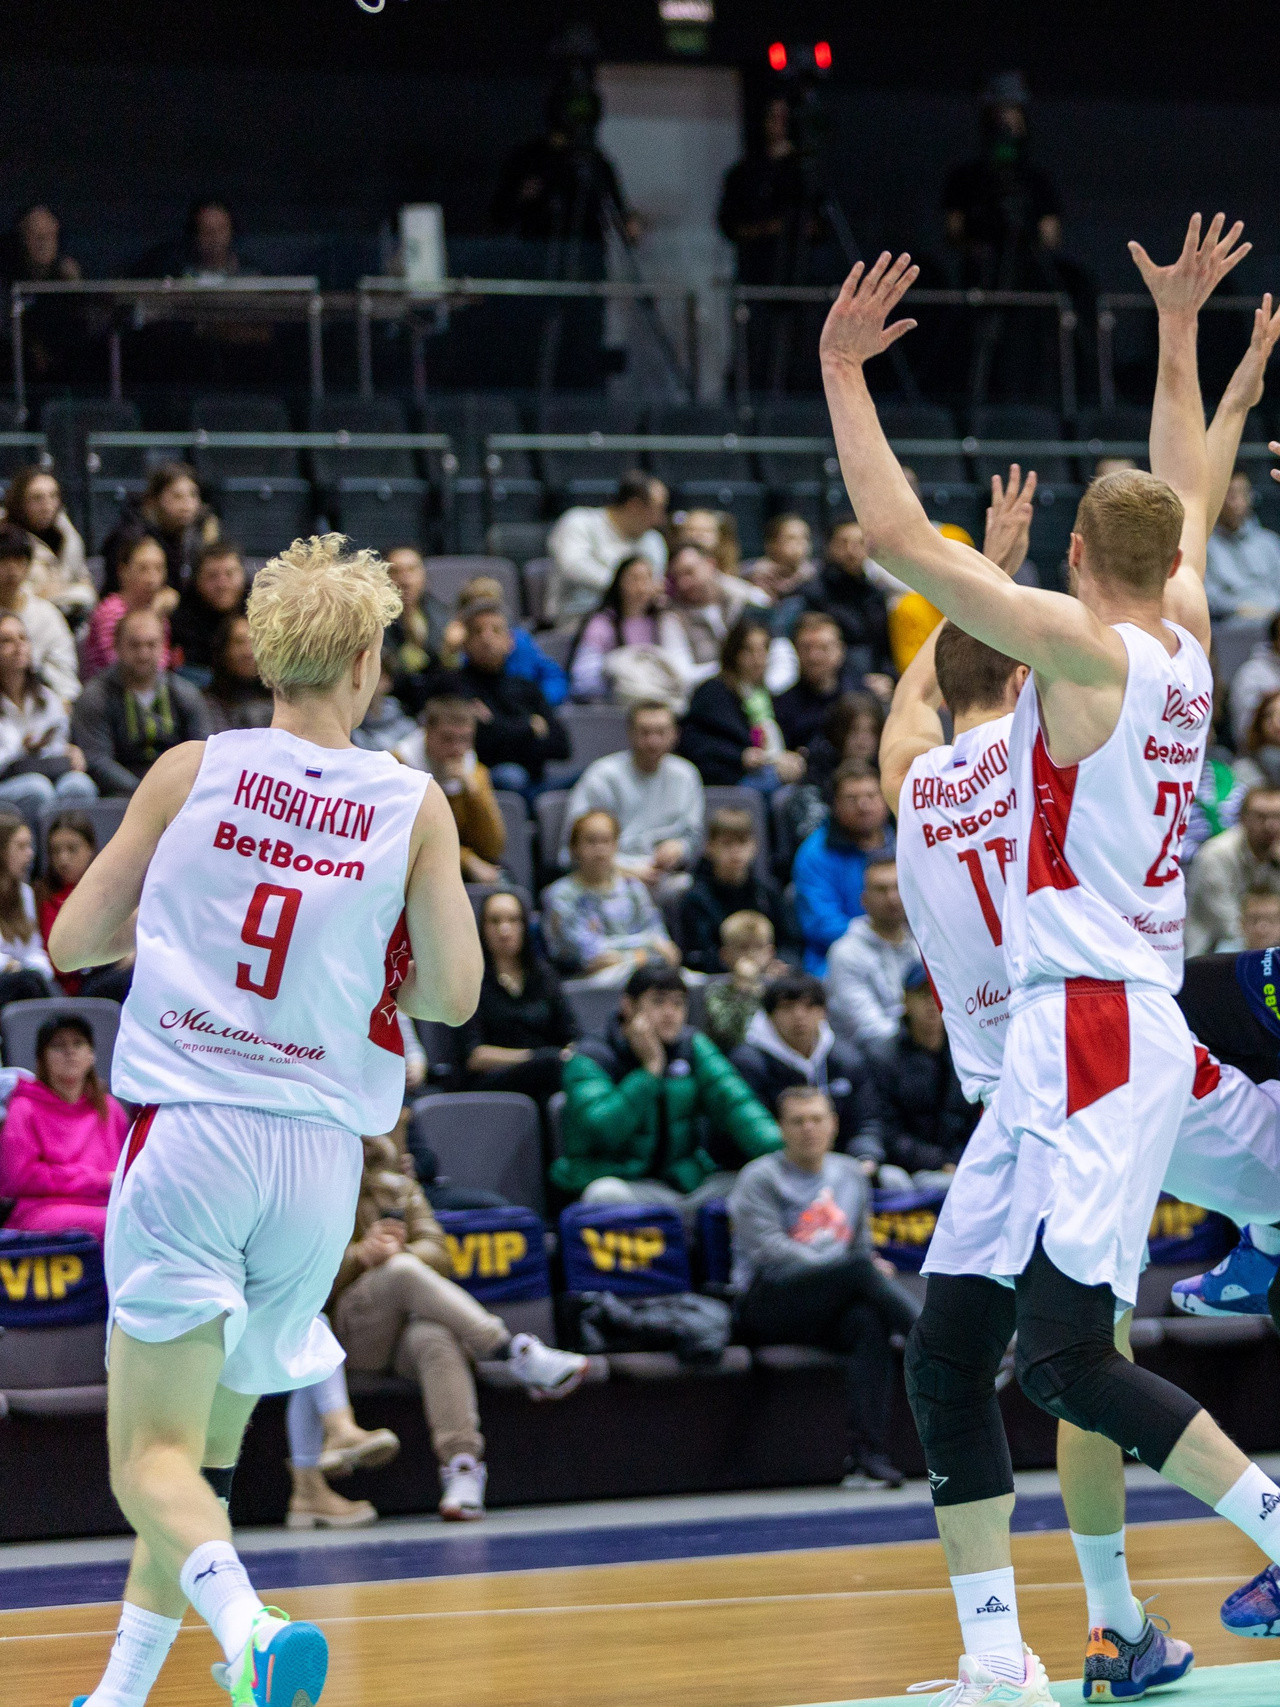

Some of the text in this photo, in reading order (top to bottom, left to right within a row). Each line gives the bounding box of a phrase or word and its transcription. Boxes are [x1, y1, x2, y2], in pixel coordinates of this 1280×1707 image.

[233, 769, 376, 842] KASATKIN
[213, 820, 365, 881] BetBoom
[235, 882, 303, 1000] 9
[445, 1231, 528, 1279] VIP
[581, 1226, 665, 1273] VIP
[0, 1254, 84, 1300] VIP
[976, 1604, 1011, 1614] PEAK
